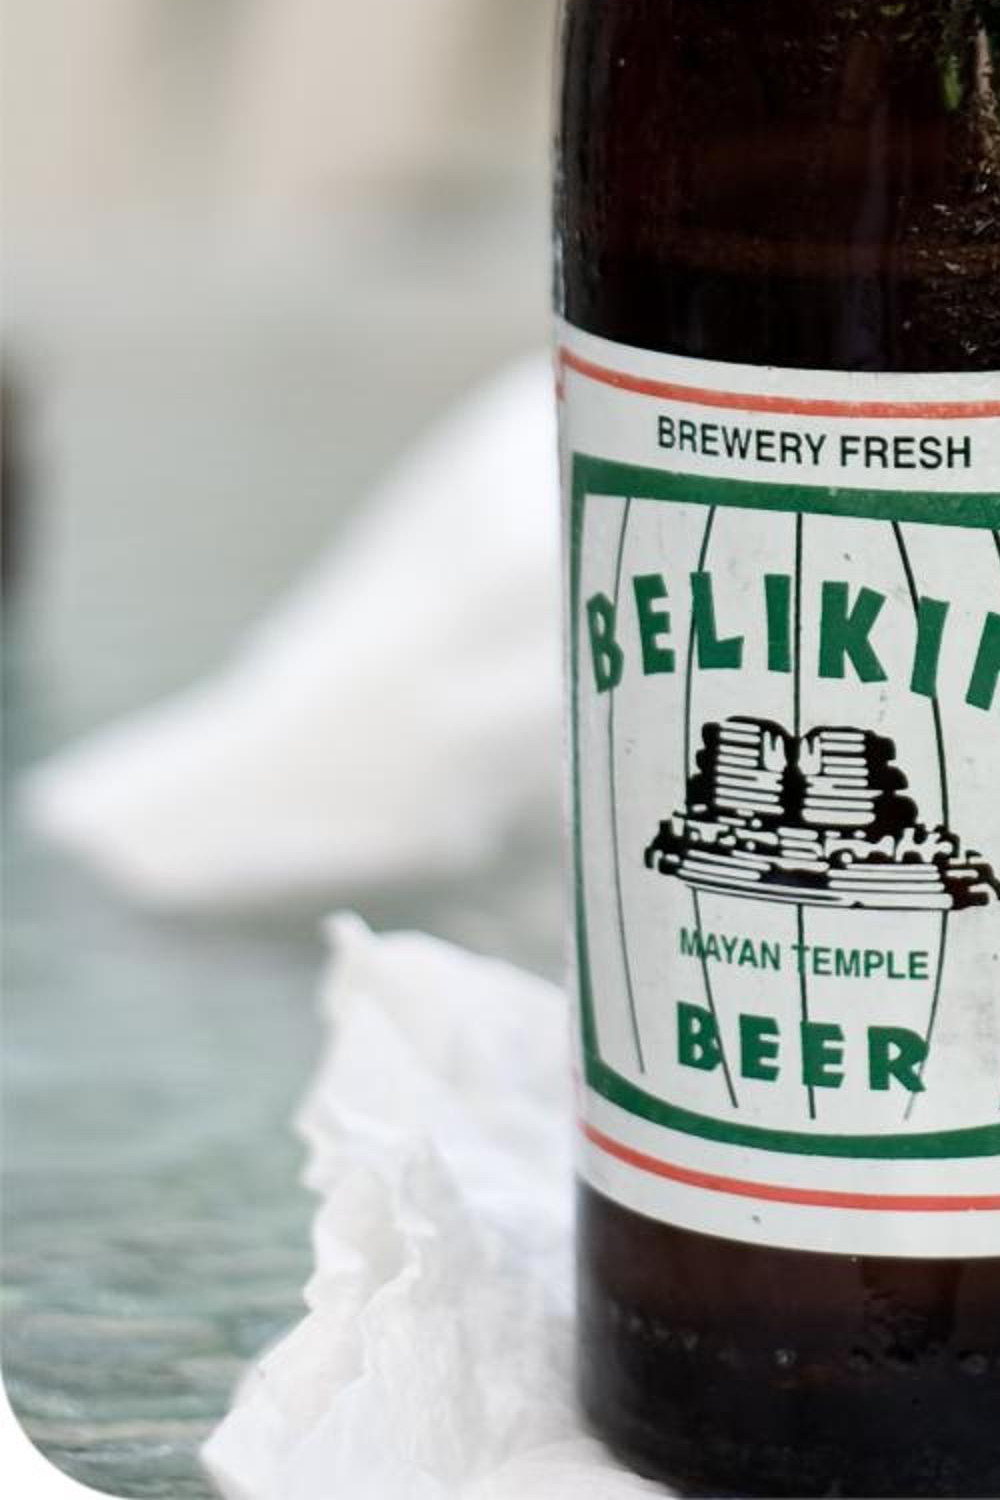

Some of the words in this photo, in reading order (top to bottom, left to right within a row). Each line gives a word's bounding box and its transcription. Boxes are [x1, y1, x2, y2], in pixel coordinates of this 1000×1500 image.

[657, 415, 826, 466] BREWERY
[838, 435, 972, 469] FRESH
[679, 927, 782, 971] MAYAN
[792, 944, 929, 980] TEMPLE
[677, 1001, 930, 1092] BEER
